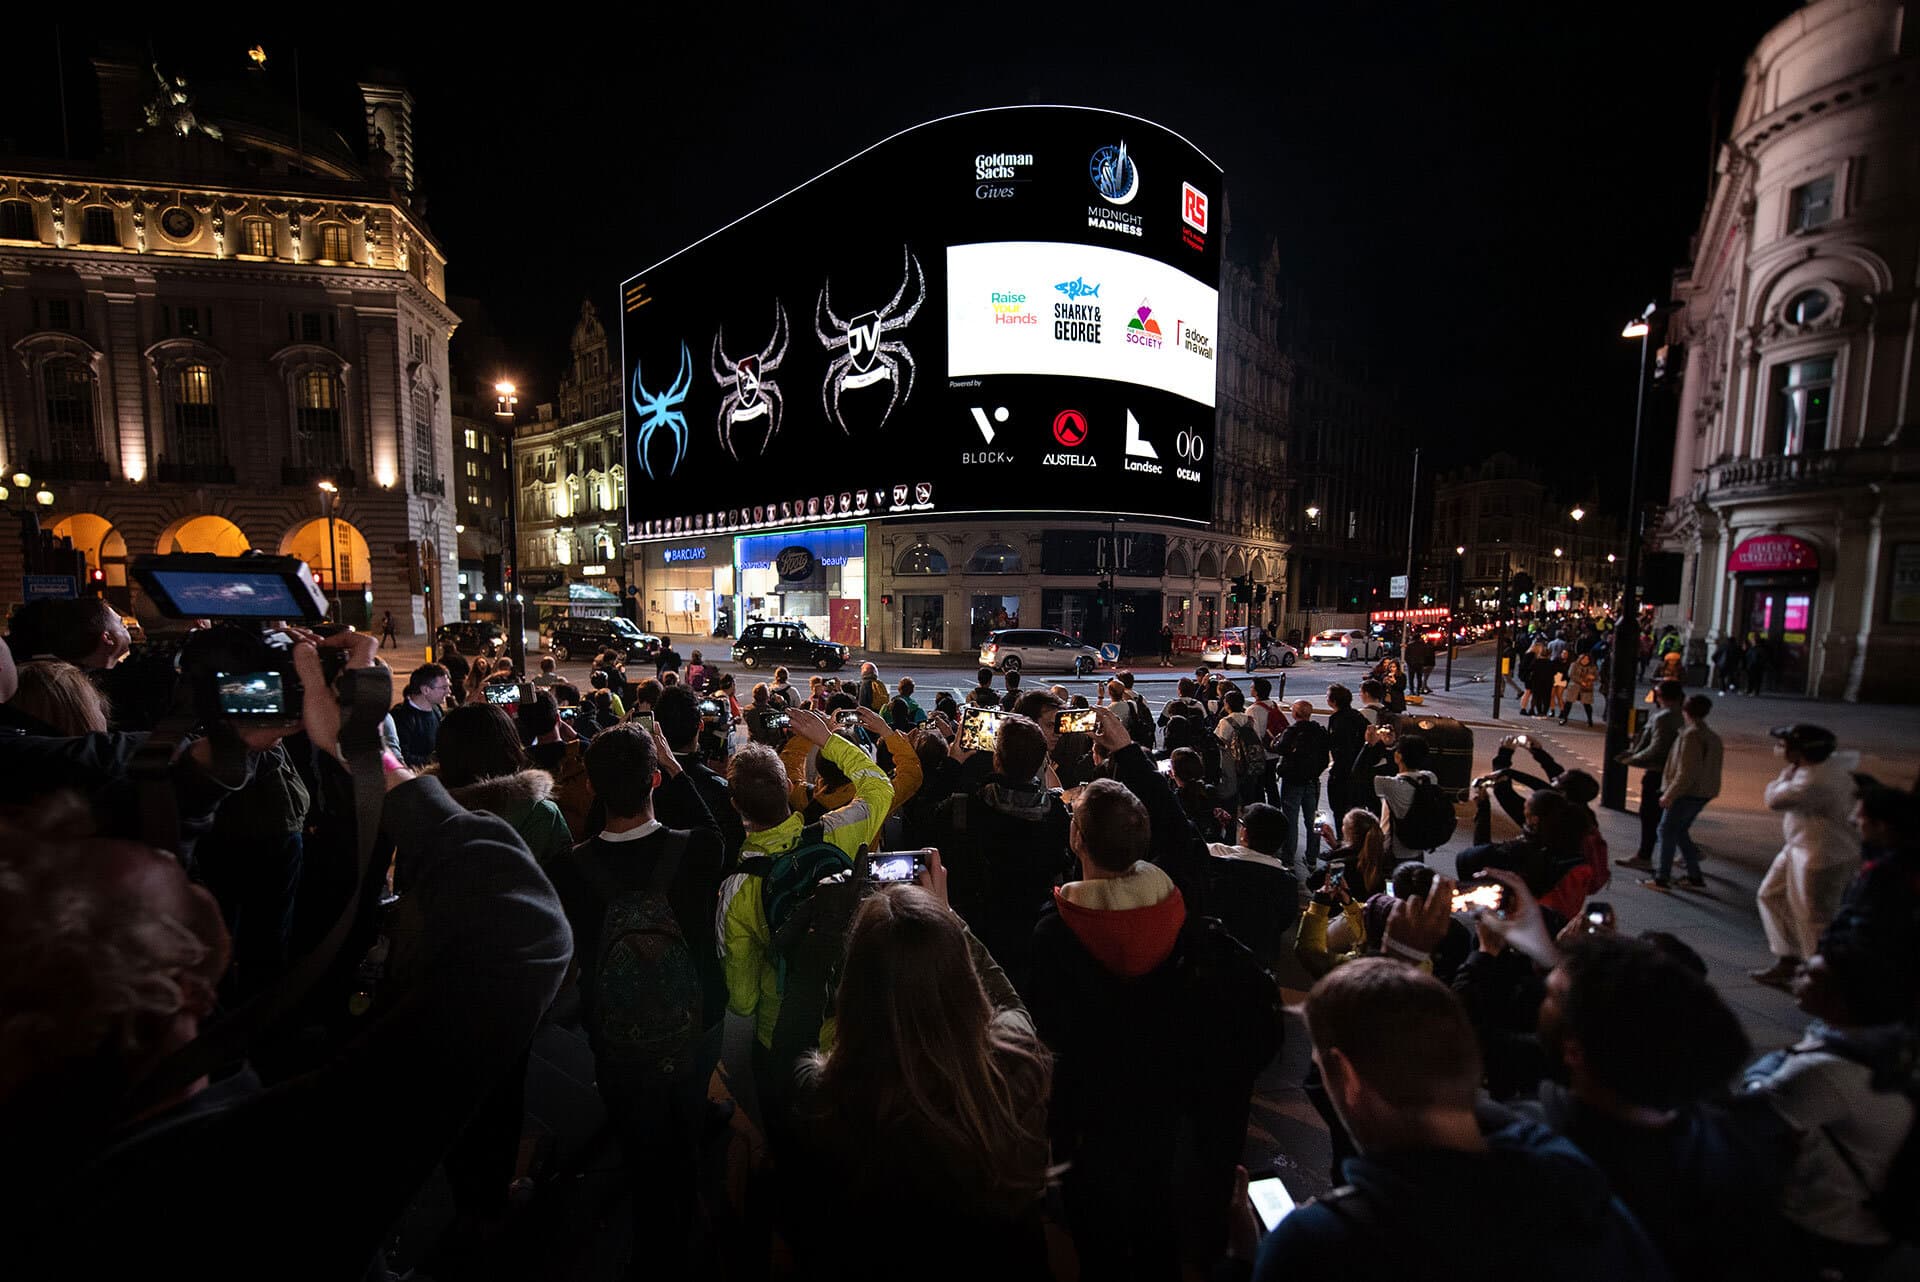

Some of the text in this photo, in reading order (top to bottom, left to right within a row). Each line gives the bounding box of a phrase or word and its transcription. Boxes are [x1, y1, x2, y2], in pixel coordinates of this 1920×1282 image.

[975, 153, 1033, 168] Goldman
[975, 165, 1015, 180] Sachs
[975, 184, 1015, 200] Gives
[1088, 206, 1143, 226] MIDNIGHT
[1088, 217, 1143, 237] MADNESS
[991, 291, 1026, 304] Raise
[991, 303, 1023, 313] Your
[995, 312, 1038, 325] Hands
[849, 321, 879, 356] JV
[1054, 320, 1101, 344] GEORGE
[1126, 333, 1162, 350] SOCIETY
[949, 378, 983, 389] Powered by
[1043, 453, 1097, 467] AUSTELLA
[1125, 458, 1162, 474] Landsec
[1176, 467, 1201, 482] OCEAN
[671, 547, 706, 561] BARCLAYS
[821, 555, 848, 567] beauty
